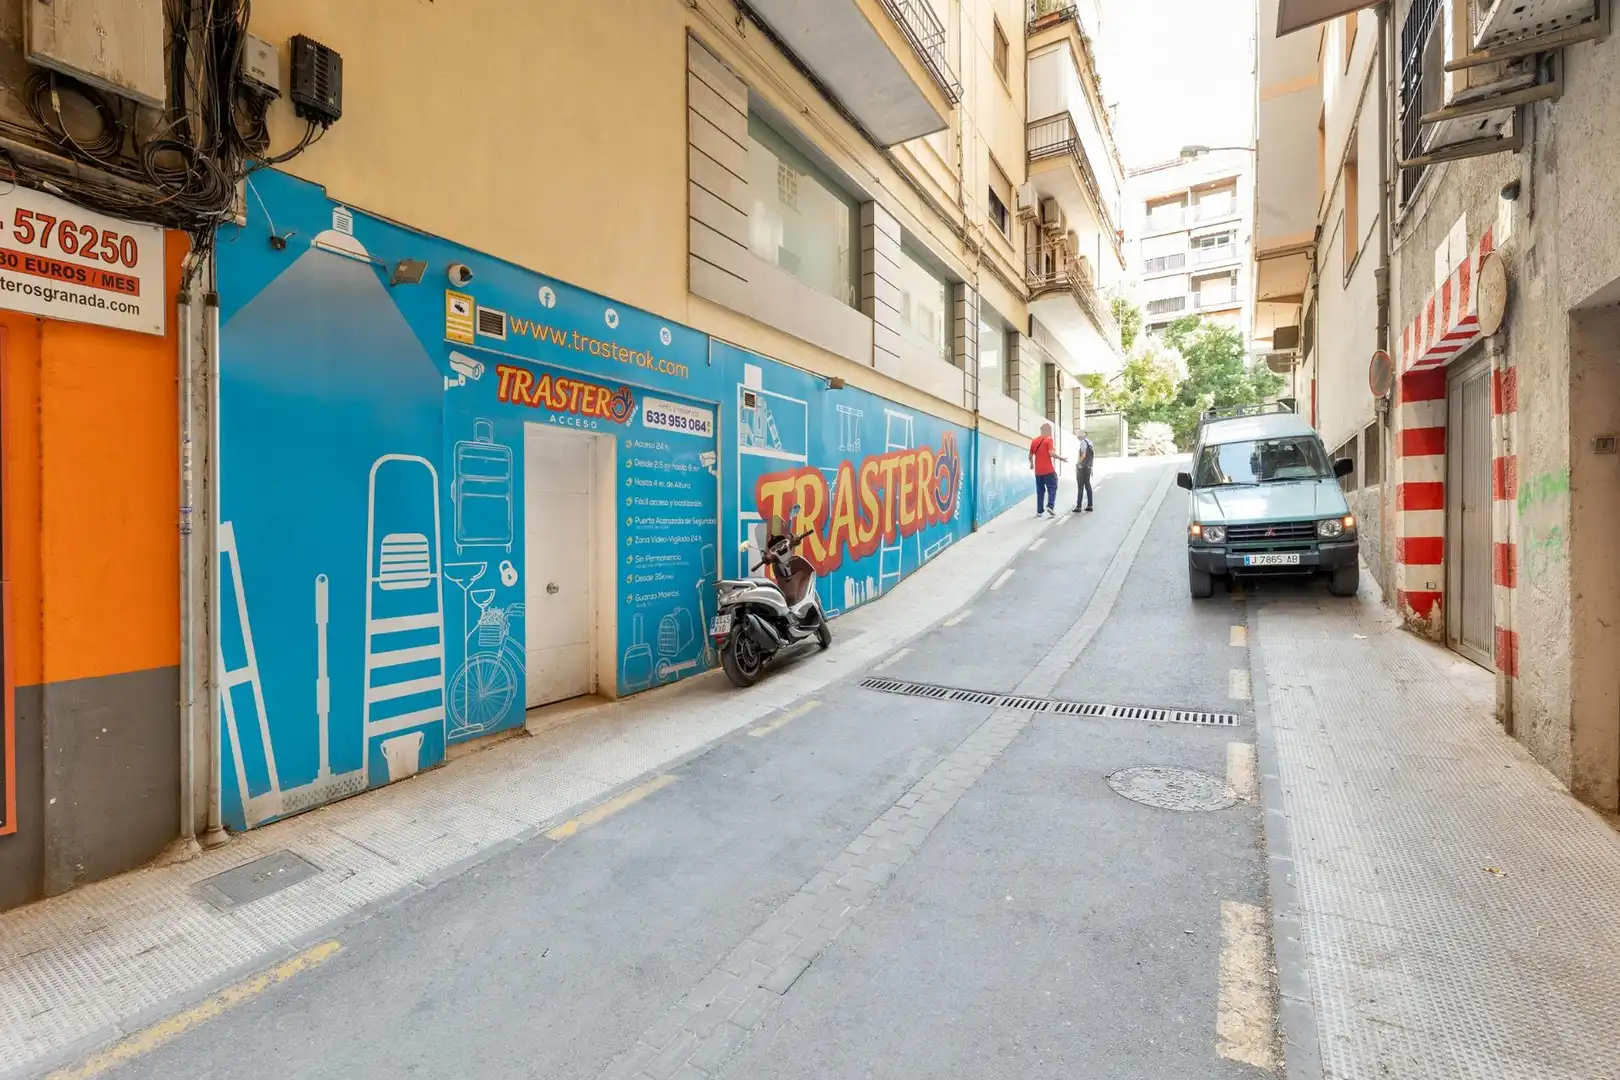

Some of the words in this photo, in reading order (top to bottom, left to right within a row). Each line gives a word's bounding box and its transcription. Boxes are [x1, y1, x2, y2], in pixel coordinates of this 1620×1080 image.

[13, 207, 138, 269] 576250
[25, 257, 87, 282] EUROS
[101, 274, 136, 292] MES
[509, 315, 689, 379] www.trasterok.com
[549, 413, 597, 429] ACCESO
[646, 410, 667, 425] 633
[668, 414, 687, 429] 953
[688, 418, 706, 433] 064
[633, 440, 655, 449] Acceso
[655, 442, 664, 450] 24
[634, 458, 653, 468] Desde
[634, 477, 653, 487] Hasta
[666, 480, 674, 488] de
[674, 481, 691, 490] Altura
[649, 498, 669, 507] acceso
[634, 516, 654, 525] Puerta
[685, 516, 692, 525] de
[634, 535, 650, 544] Zona
[634, 554, 645, 563] Sin
[1260, 555, 1283, 564] 7865
